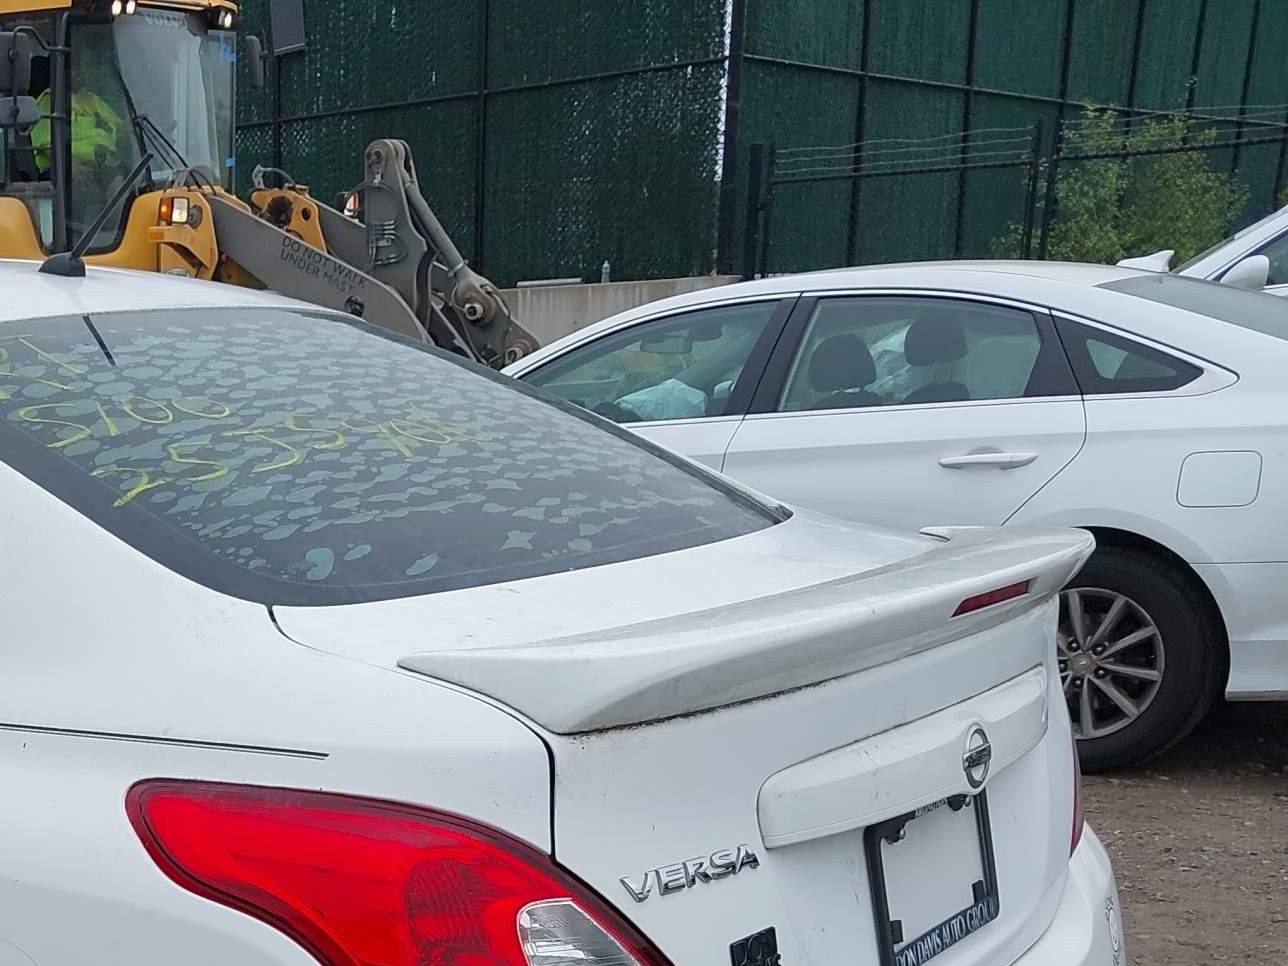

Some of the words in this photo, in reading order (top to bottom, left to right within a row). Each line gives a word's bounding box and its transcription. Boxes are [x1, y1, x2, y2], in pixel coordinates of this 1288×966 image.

[280, 249, 321, 278] UNDER
[322, 272, 355, 295] MAST
[282, 236, 302, 253] DO
[305, 246, 331, 267] NOT
[334, 262, 369, 289] WALK
[618, 843, 761, 903] VERSA
[917, 929, 943, 964] DAVIS
[942, 915, 966, 949] AUTO
